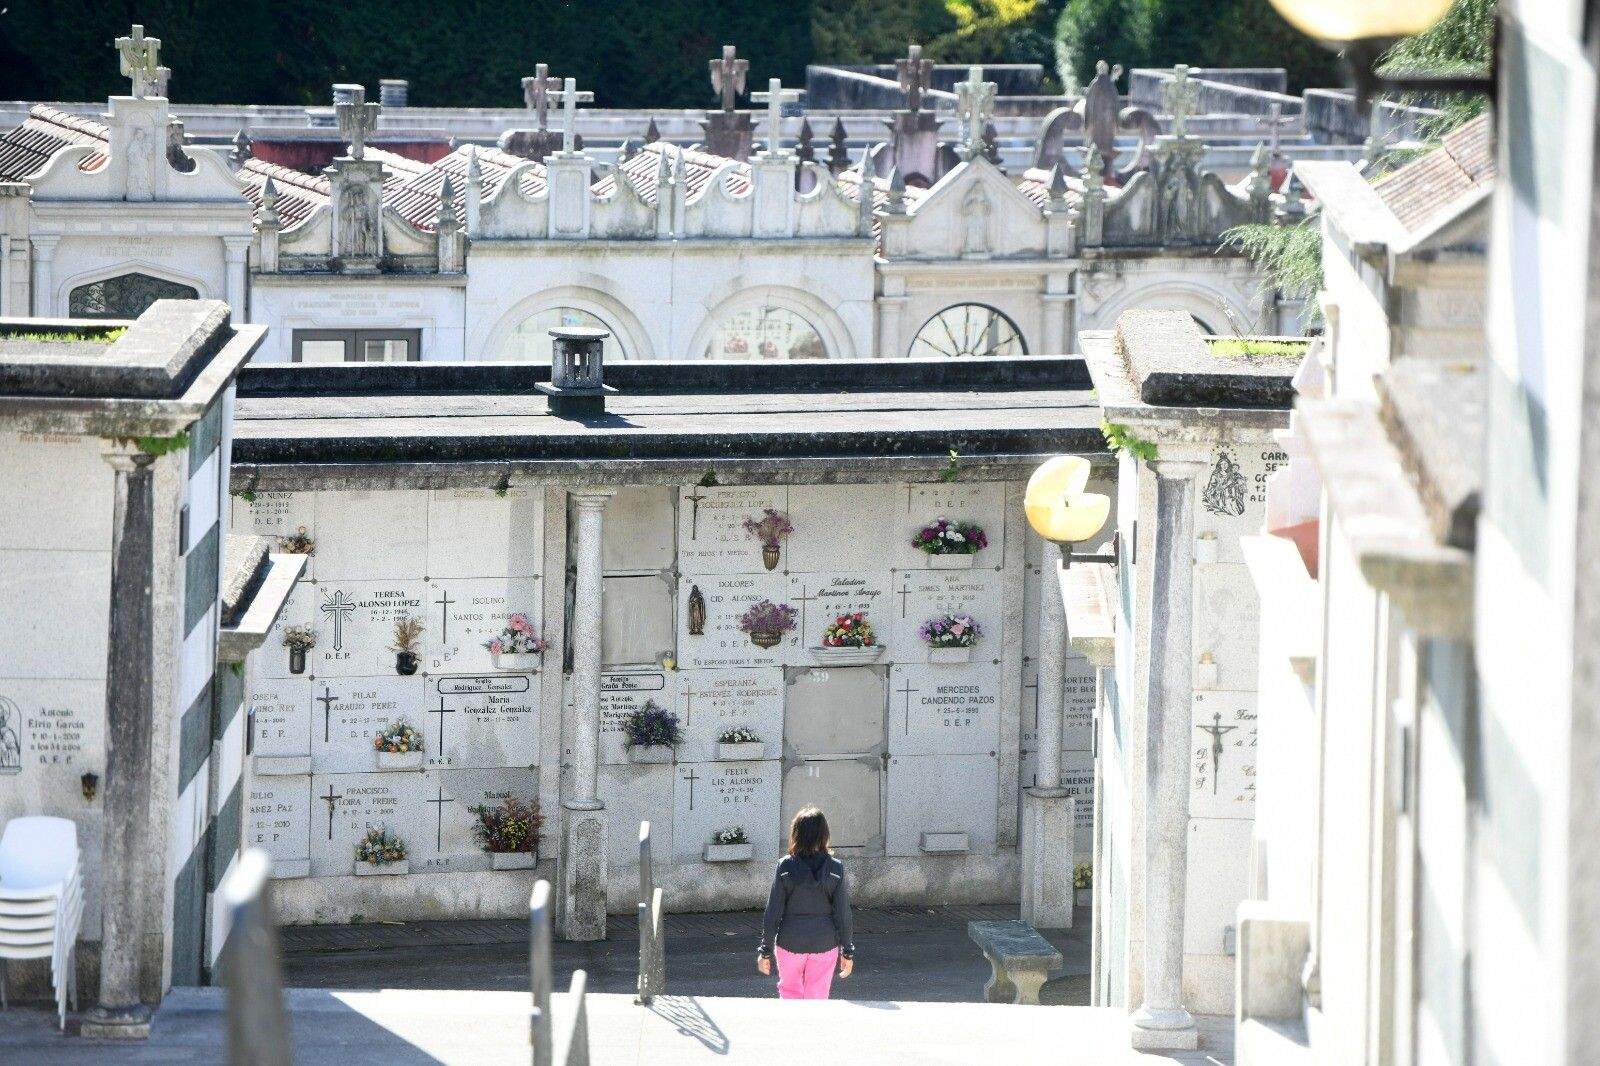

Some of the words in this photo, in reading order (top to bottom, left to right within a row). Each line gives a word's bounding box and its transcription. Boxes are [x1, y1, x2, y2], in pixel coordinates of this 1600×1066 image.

[718, 580, 755, 588] DOLORES
[373, 590, 405, 598] TERESA
[358, 600, 391, 608] ALONSO
[393, 599, 420, 607] LOPEZ
[453, 613, 484, 621] SANTOS
[936, 685, 980, 694] MERCEDES
[968, 695, 995, 704] PAZOS
[725, 768, 749, 776] FELIX
[711, 778, 725, 786] LIS
[730, 777, 763, 786] ALONSO
[346, 787, 389, 795] FRANCISCO
[277, 803, 293, 812] PAZ
